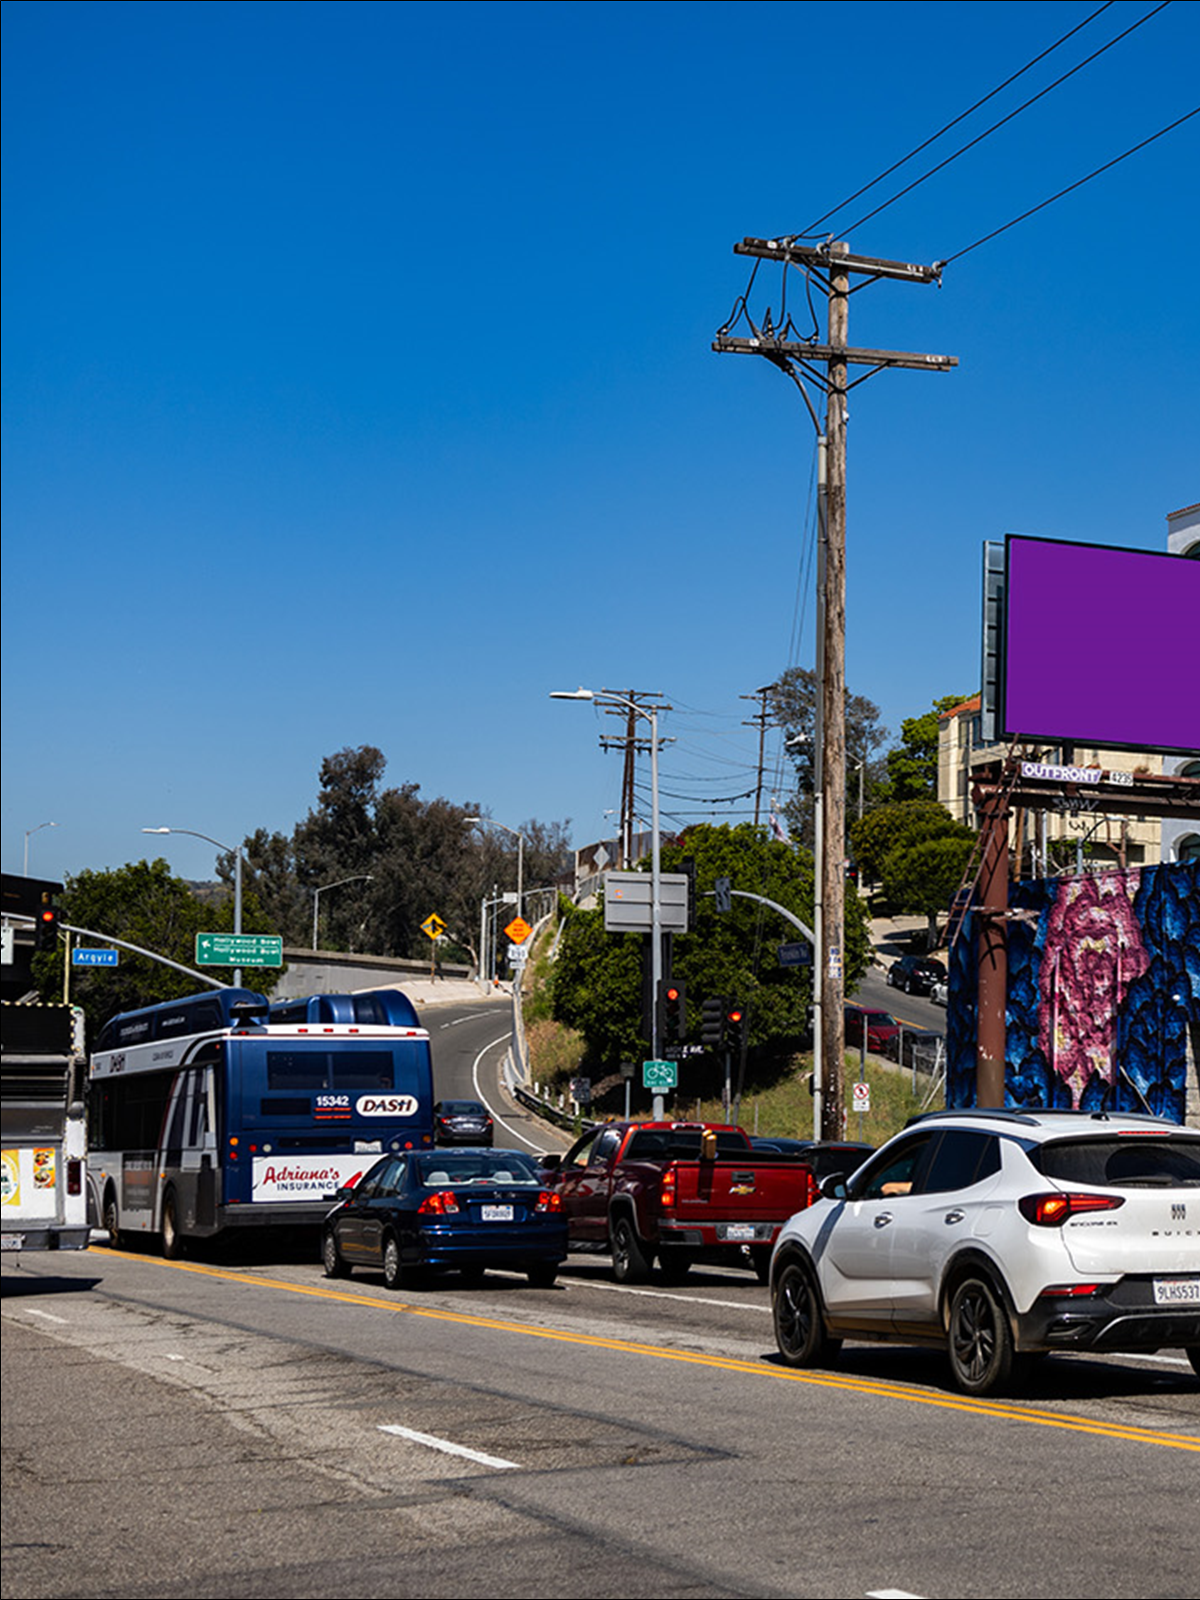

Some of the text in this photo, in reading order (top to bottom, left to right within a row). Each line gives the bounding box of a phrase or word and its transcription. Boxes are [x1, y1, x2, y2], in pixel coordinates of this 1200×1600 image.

[1023, 763, 1100, 783] OUTFRONT
[78, 952, 113, 963] Argyle
[315, 1095, 413, 1112] 15342 DASH
[263, 1166, 340, 1185] Adriana's
[276, 1181, 339, 1191] INSURANCE
[1157, 1285, 1200, 1300] 9LHS537
